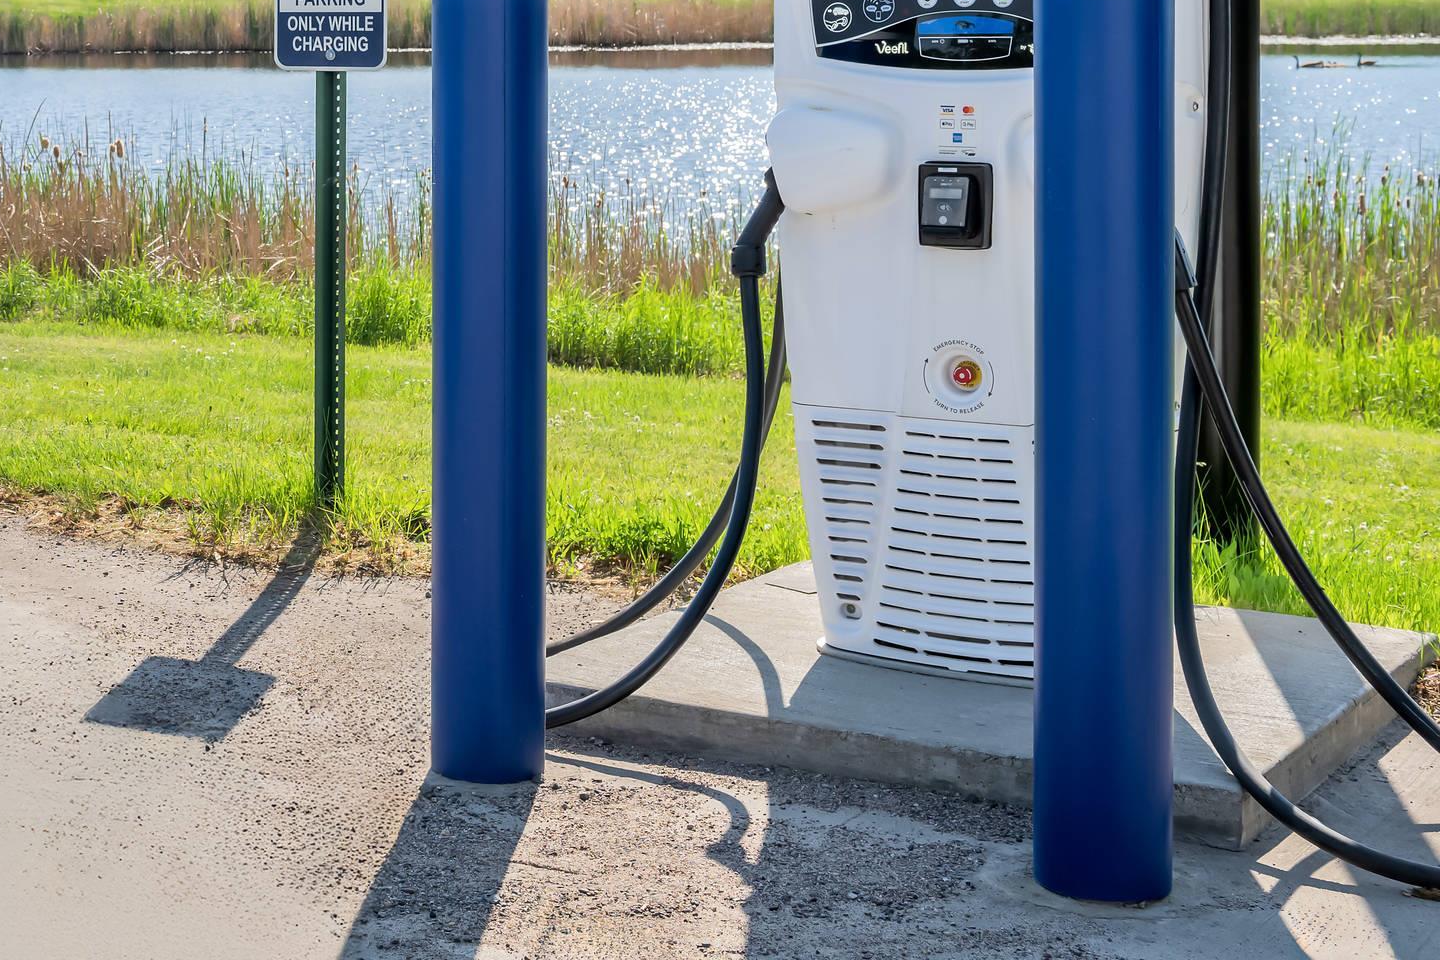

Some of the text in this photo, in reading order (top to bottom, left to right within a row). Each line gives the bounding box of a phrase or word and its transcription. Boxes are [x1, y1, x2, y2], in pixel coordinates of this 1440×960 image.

[287, 15, 374, 32] ONLY WHILE
[292, 36, 369, 52] CHARGING
[874, 40, 909, 54] Veefil
[933, 339, 985, 355] EMERGENCY STOP
[934, 398, 949, 411] TURN
[959, 401, 985, 415] RELEASE
